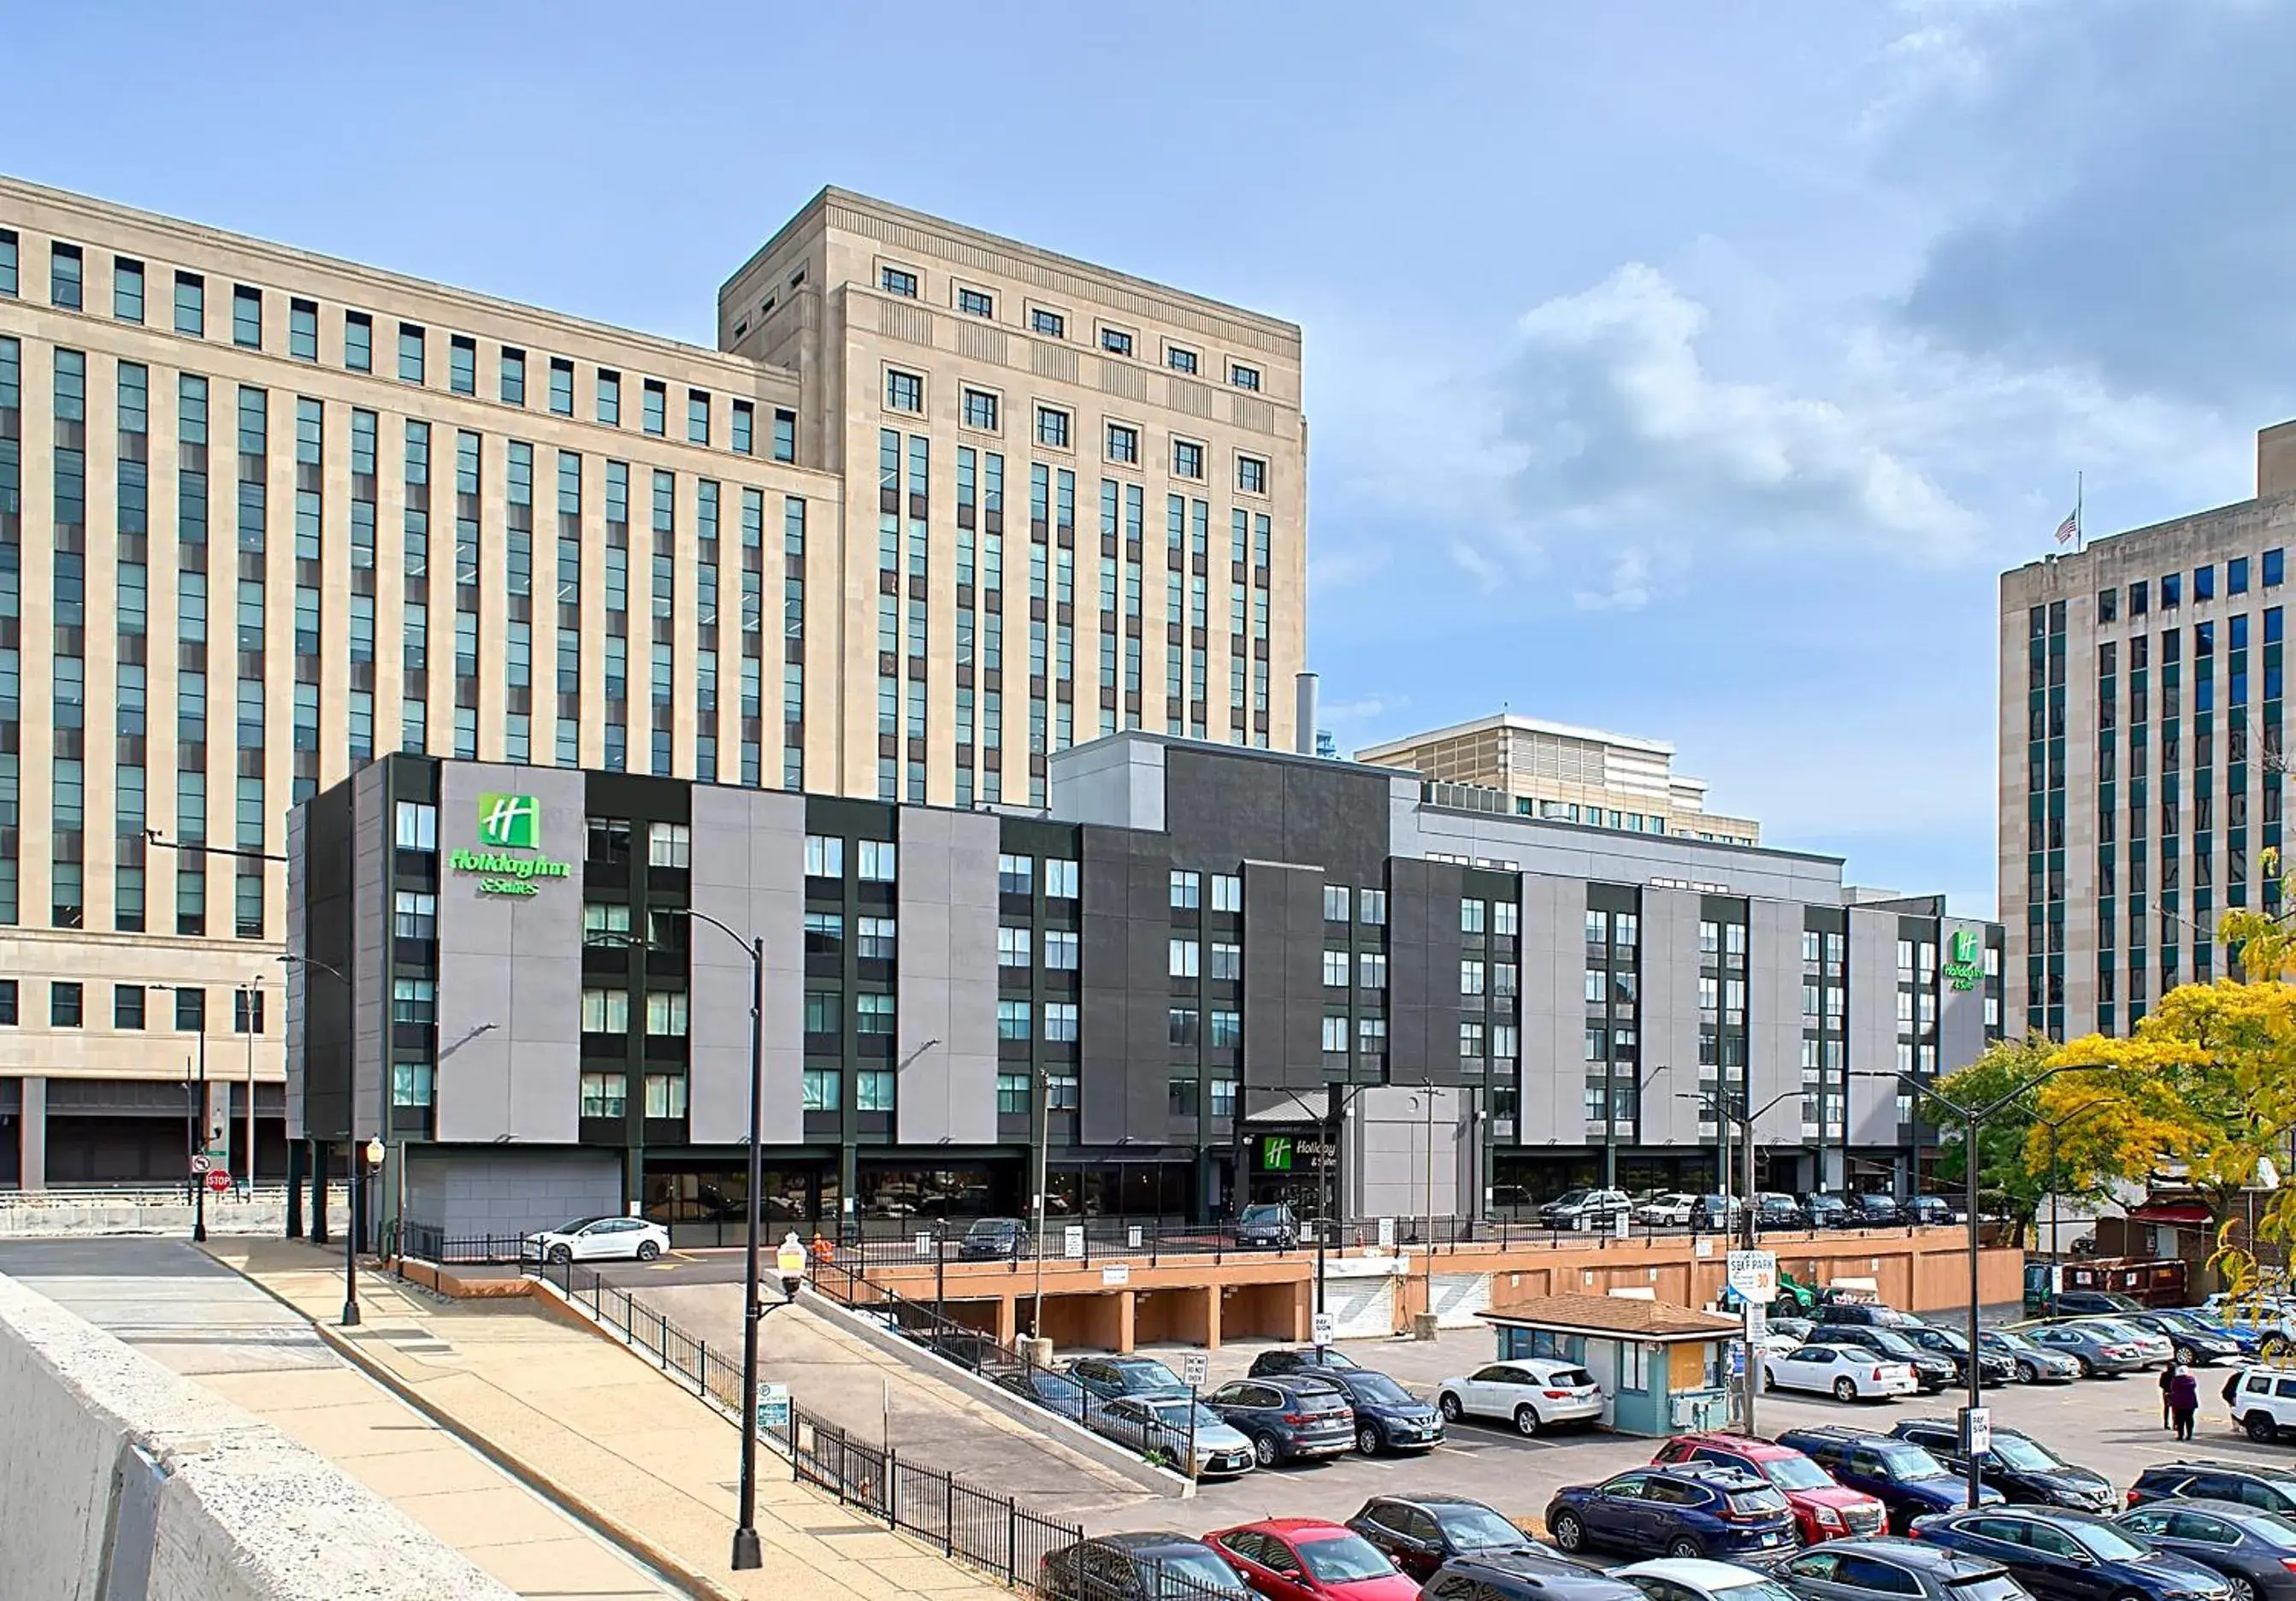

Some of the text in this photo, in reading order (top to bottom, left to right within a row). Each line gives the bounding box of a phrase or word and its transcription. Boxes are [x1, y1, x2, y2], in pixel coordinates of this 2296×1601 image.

[449, 848, 571, 879] Holiday Inn
[208, 1176, 230, 1185] STOP
[1731, 1259, 1773, 1271] SELF PARK
